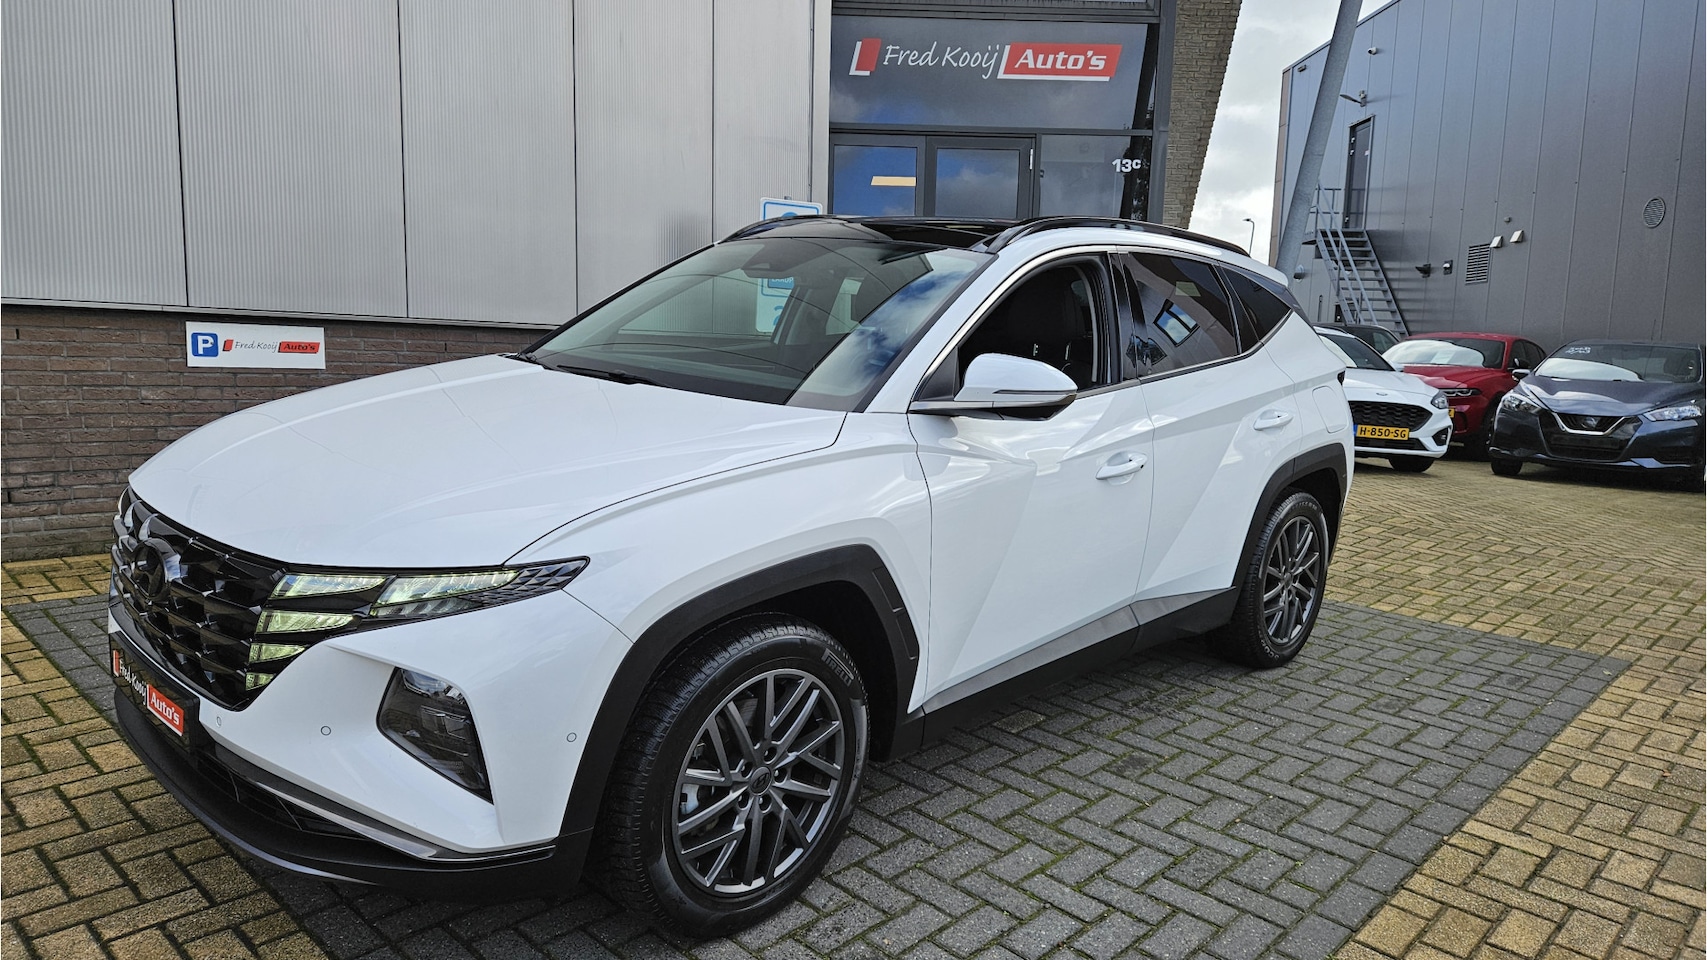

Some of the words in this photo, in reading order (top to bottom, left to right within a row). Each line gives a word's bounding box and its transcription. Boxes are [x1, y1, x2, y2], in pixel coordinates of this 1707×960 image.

[883, 41, 939, 67] Fred
[941, 44, 999, 79] Kooij
[1014, 48, 1107, 71] Auto's
[197, 335, 214, 354] P
[234, 341, 256, 350] Fred
[256, 341, 278, 353] Kooij
[284, 343, 315, 351] Auto's
[1359, 426, 1407, 438] H-850-SG
[821, 648, 854, 687] PIRELLI
[119, 658, 132, 683] Fred
[131, 672, 147, 706] Kooij
[150, 692, 180, 726] Auto's
